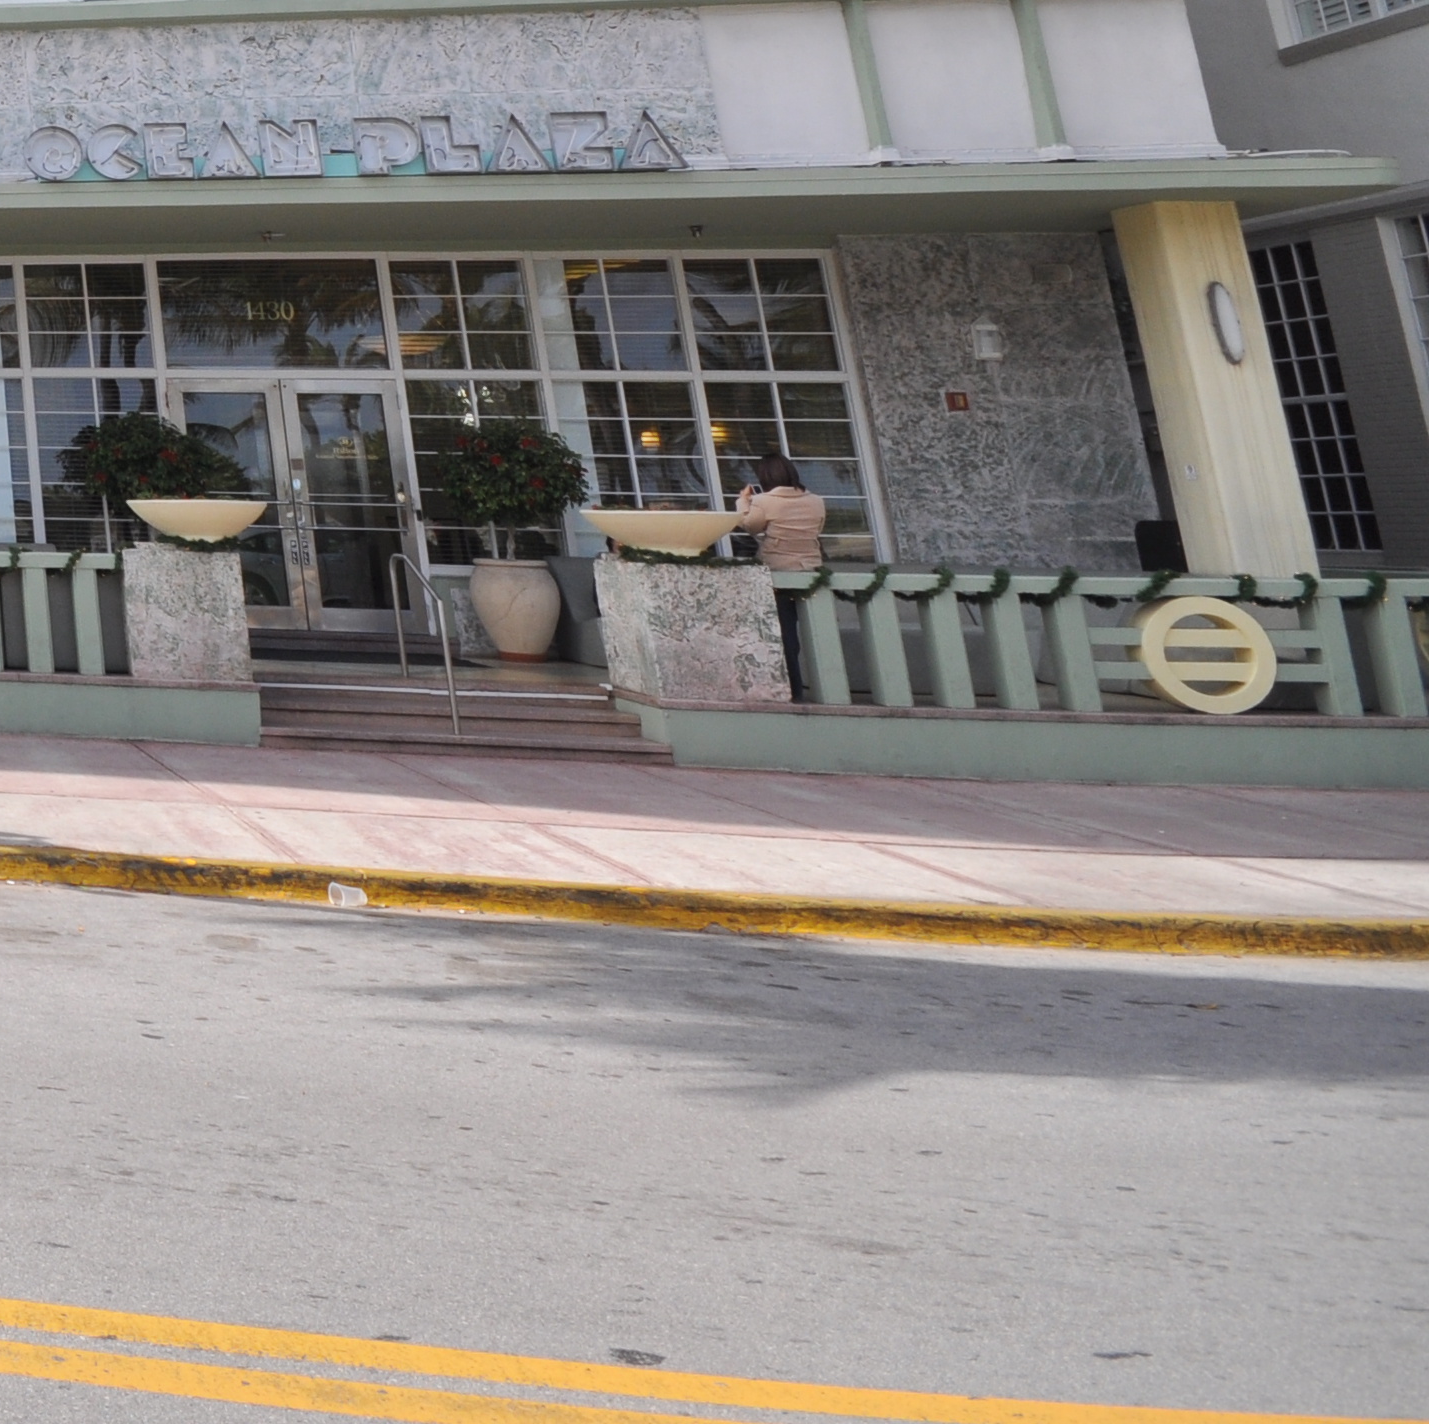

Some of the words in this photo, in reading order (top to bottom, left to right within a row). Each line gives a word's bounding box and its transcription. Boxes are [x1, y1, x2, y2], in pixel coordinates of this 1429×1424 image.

[24, 119, 323, 182] OCEAN
[353, 110, 690, 176] PLAZA
[246, 301, 295, 321] 1430
